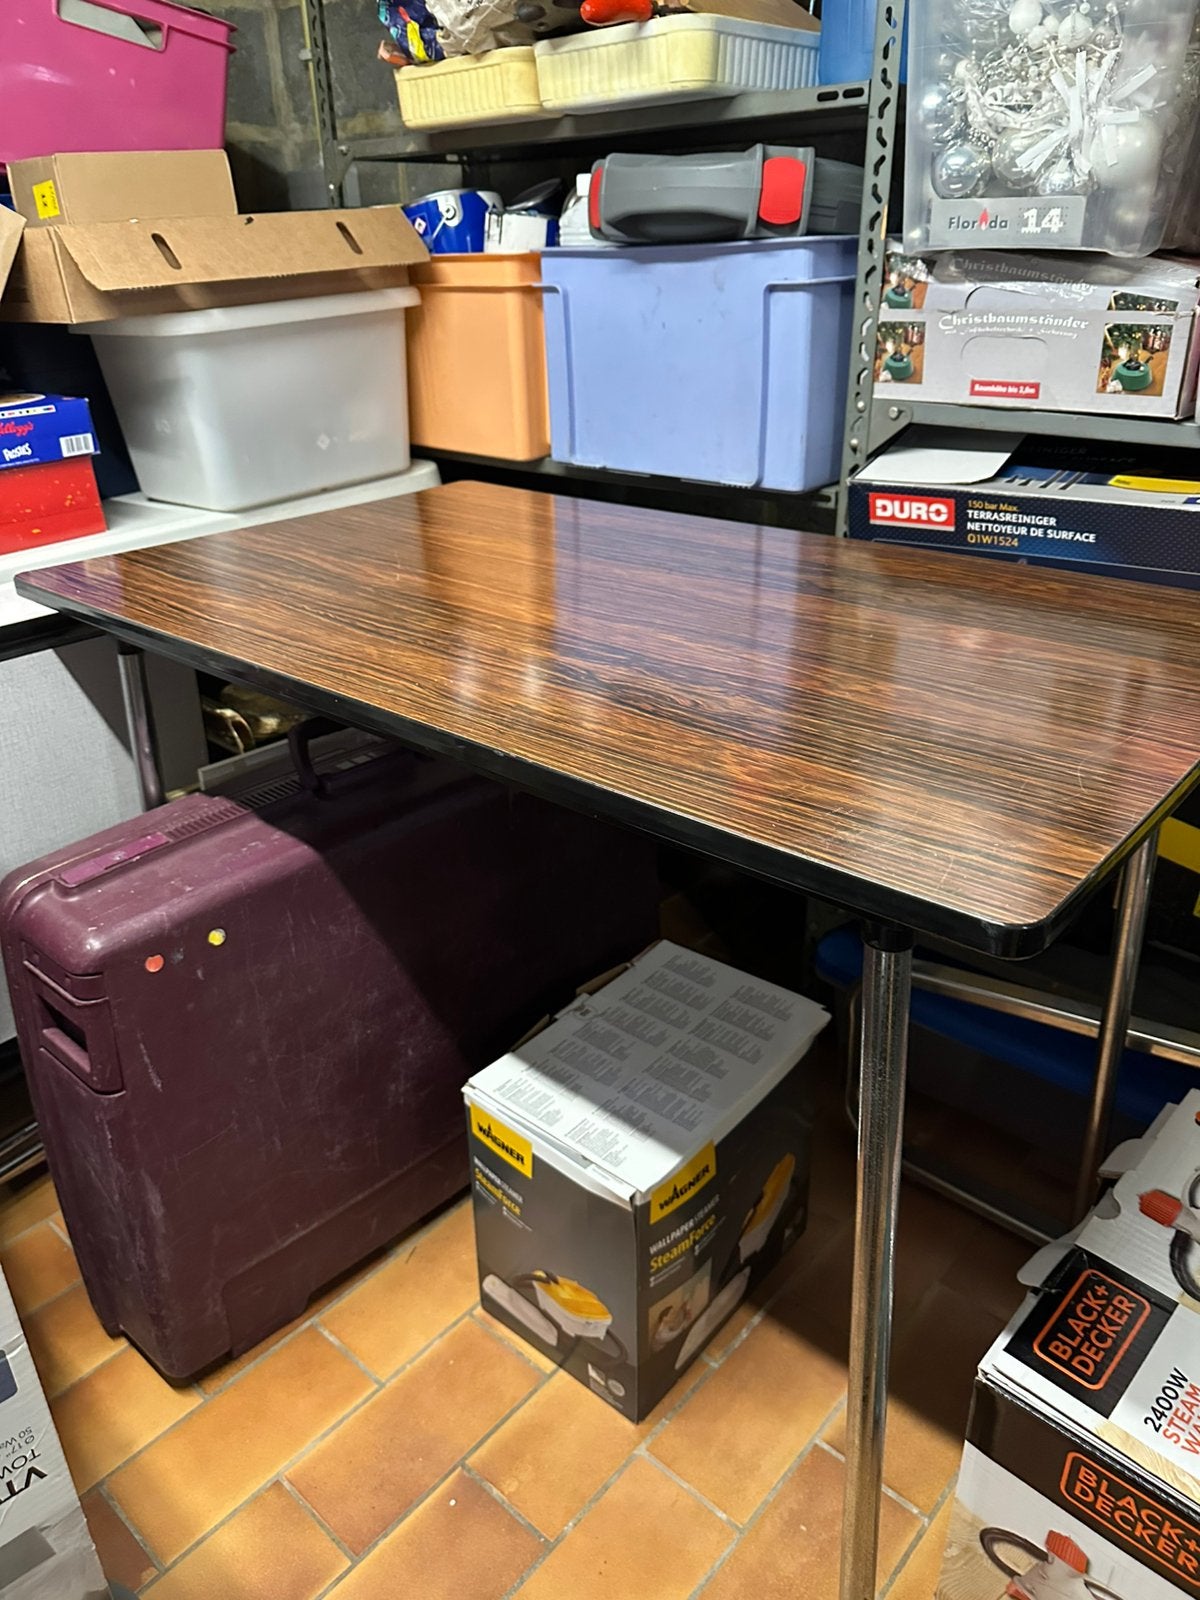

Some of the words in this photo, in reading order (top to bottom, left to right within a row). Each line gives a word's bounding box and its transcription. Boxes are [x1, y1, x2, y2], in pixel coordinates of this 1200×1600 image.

[948, 207, 1009, 231] Florida
[1021, 206, 1064, 234] 14
[938, 312, 1090, 331] Christbaumständer
[875, 499, 949, 523] DURO
[966, 509, 1057, 527] TERRASREINIGER
[967, 500, 984, 511] 150
[984, 502, 999, 511] bar
[966, 521, 1029, 537] NETTOYEUR
[1029, 527, 1045, 538] DE
[1046, 529, 1097, 543] SURFACE
[477, 1121, 525, 1165] WAGNER
[658, 1164, 711, 1210] WAGNER
[649, 1217, 694, 1255] WALLPAPER
[650, 1213, 717, 1273] SteamForce
[1048, 1284, 1109, 1361] BLACK+
[1070, 1294, 1137, 1377] DECKER
[1143, 1366, 1189, 1433] 2400W
[18, 1426, 33, 1439] 50
[1074, 1481, 1199, 1575] DECKER
[1078, 1465, 1200, 1553] BLACK+
